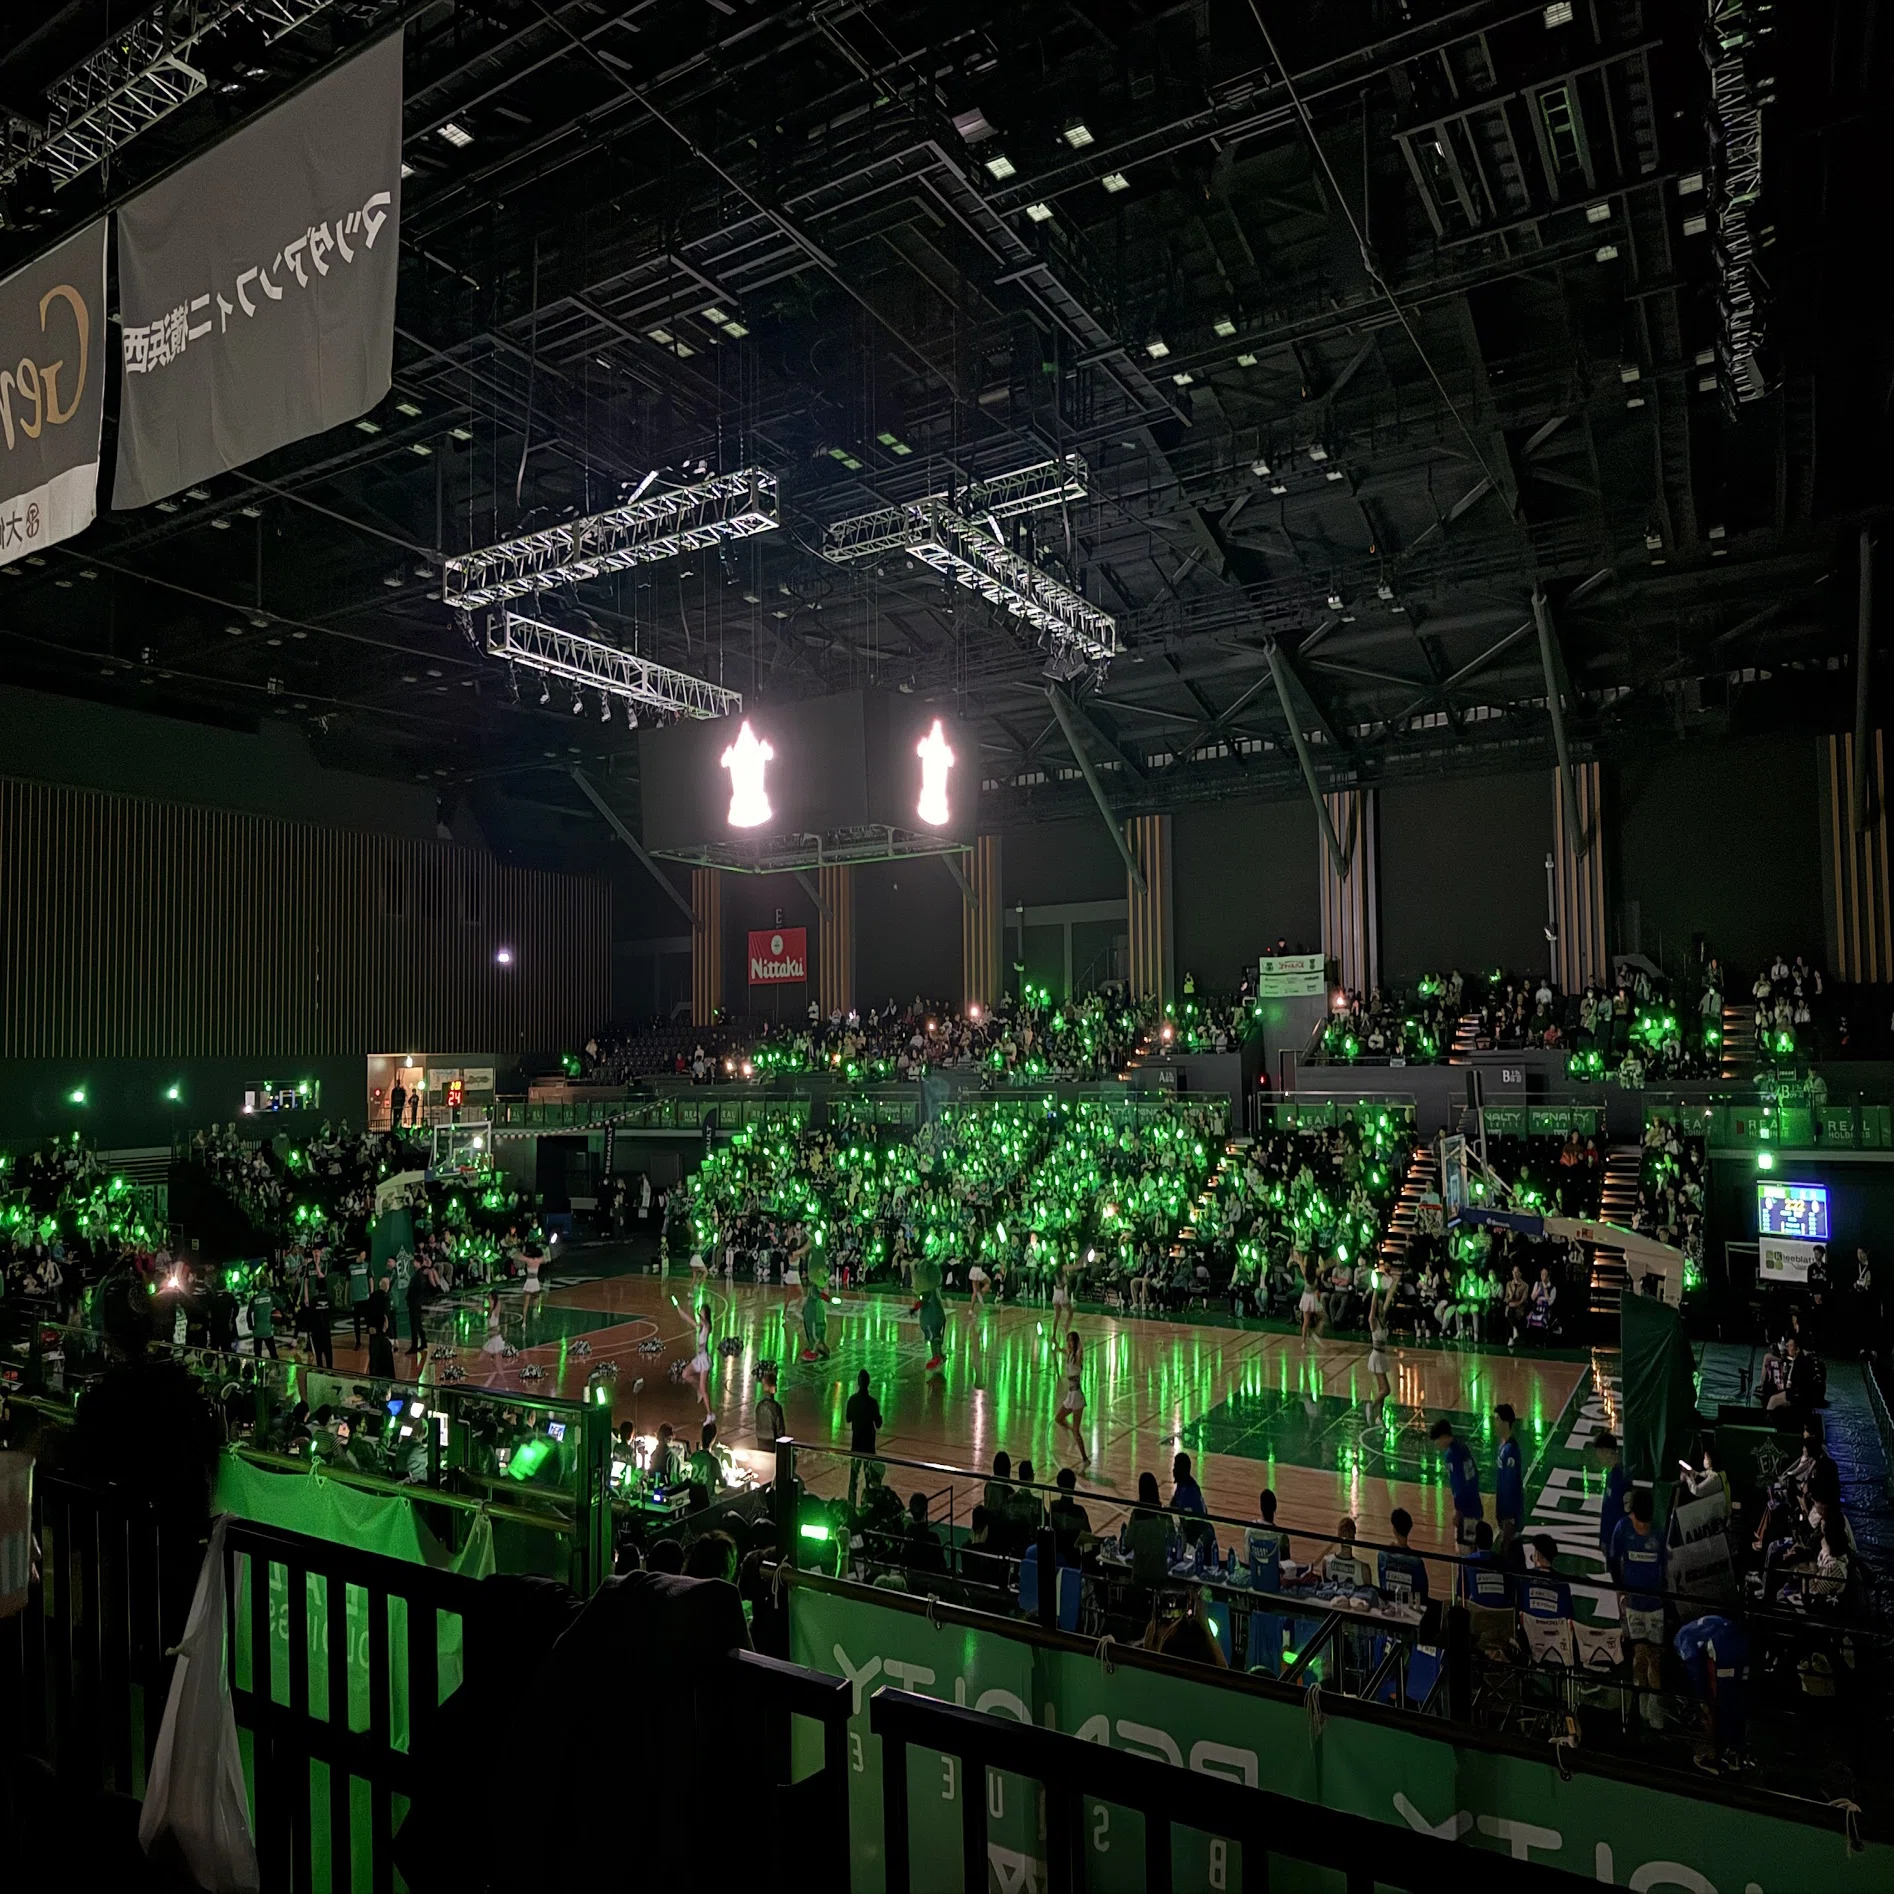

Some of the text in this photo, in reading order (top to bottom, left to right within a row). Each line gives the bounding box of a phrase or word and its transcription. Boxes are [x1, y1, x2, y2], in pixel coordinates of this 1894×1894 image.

[751, 955, 805, 980] Nittaku
[448, 1091, 461, 1106] 24
[1532, 1112, 1589, 1121] PENALTY
[1748, 1119, 1789, 1130] REAL
[705, 1125, 713, 1153] AULT
[1828, 1131, 1871, 1139] HOLDIGS
[604, 1125, 613, 1175] RENAULT
[691, 1464, 708, 1484] 24
